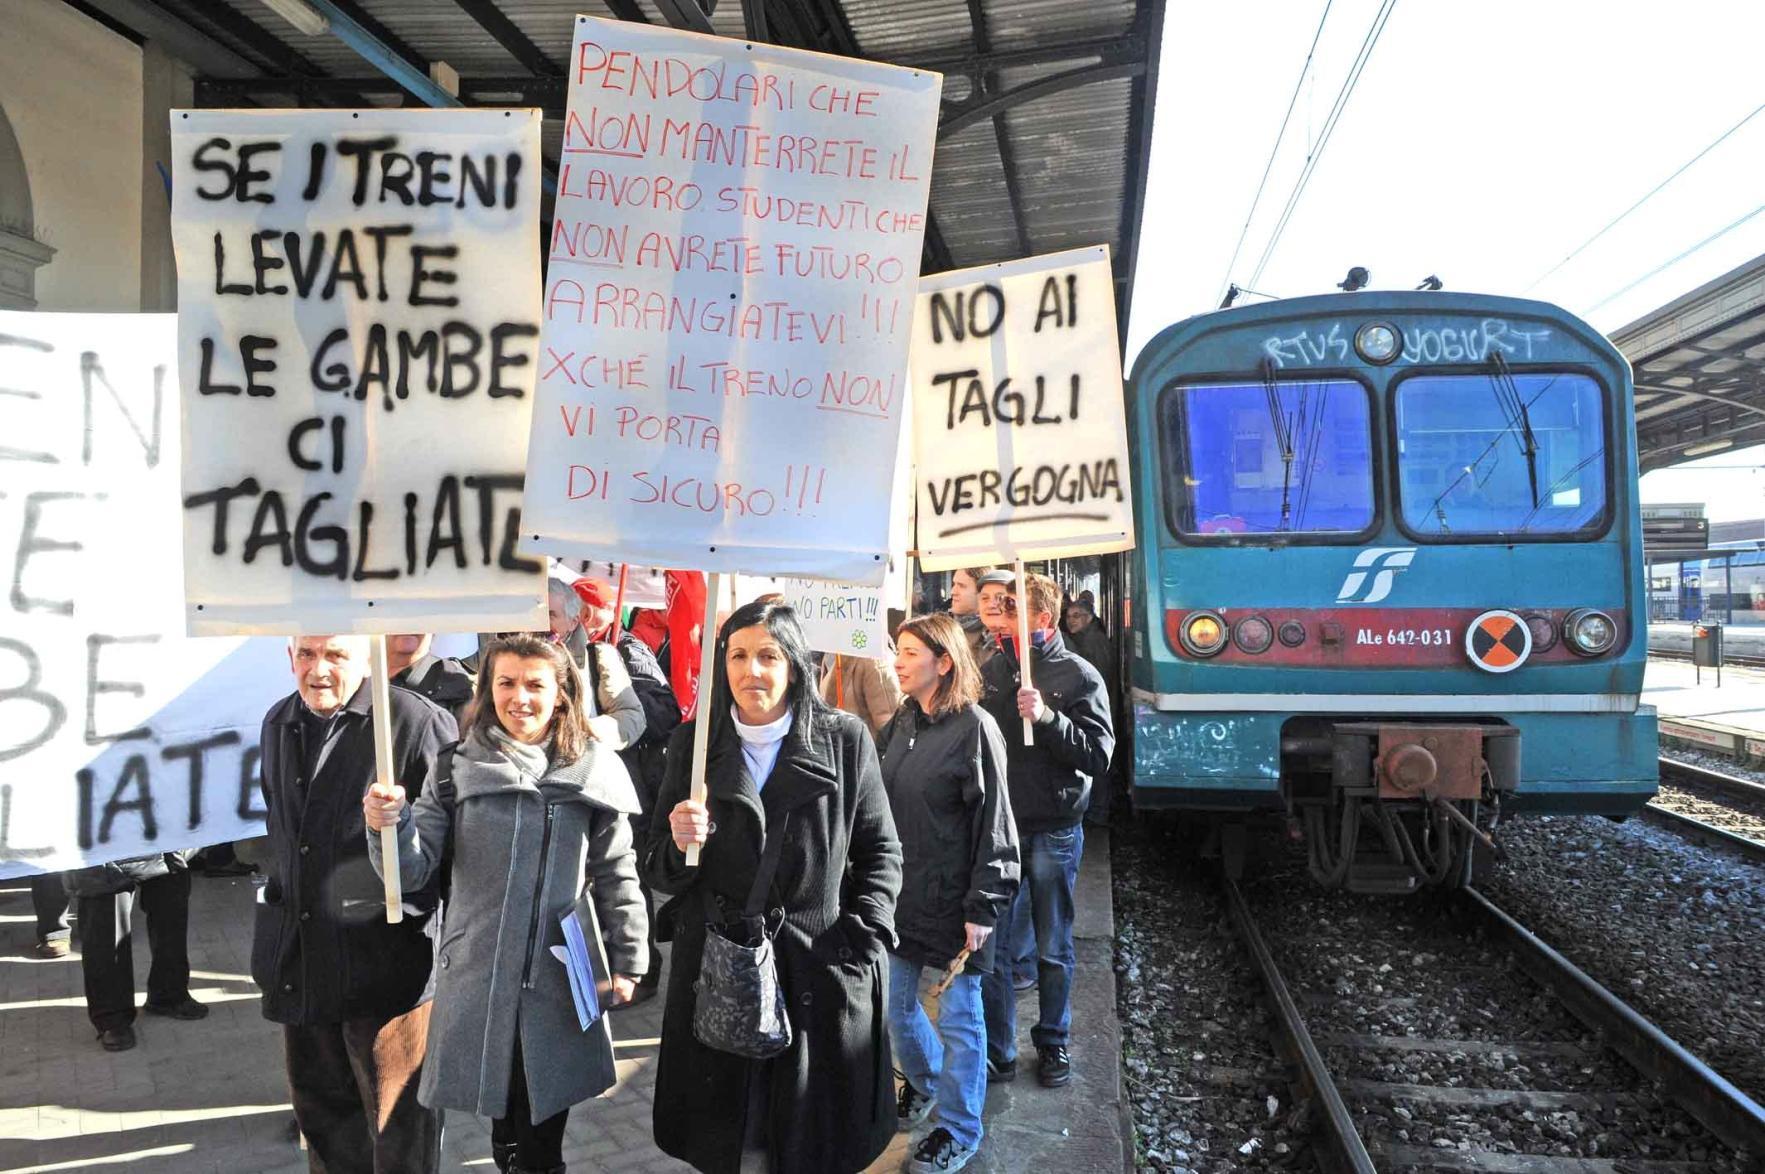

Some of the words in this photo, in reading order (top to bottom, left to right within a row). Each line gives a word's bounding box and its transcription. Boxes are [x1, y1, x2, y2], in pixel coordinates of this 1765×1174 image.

[578, 41, 795, 111] PENDOLARI
[809, 85, 880, 117] CHE
[193, 138, 282, 203] SE
[302, 141, 326, 201] I
[335, 137, 522, 208] TRENI
[564, 107, 651, 153] NON
[660, 118, 878, 180] MANTERRETE
[889, 144, 919, 181] IL
[560, 164, 702, 211] LAVORO
[717, 187, 870, 231] STUDENTI
[876, 209, 923, 234] CHE
[214, 225, 459, 306] LEVATE
[551, 219, 629, 264] NON
[637, 232, 765, 274] AVRETE
[774, 244, 903, 284] FUTURO
[930, 284, 1006, 343] NO
[1034, 273, 1077, 333] AI
[200, 335, 277, 397] LE
[311, 321, 539, 412] GAMBE
[669, 354, 695, 392] IL
[699, 361, 813, 398] TRENO
[820, 371, 895, 411] NON
[560, 404, 595, 436] VI
[615, 406, 720, 452] PORTA
[931, 369, 1080, 430] TAGLI
[288, 415, 346, 473] CI
[567, 463, 608, 499] DI
[927, 458, 1124, 516] VERGOGNA
[1356, 628, 1382, 645] ALe
[1387, 628, 1451, 645] 642-031
